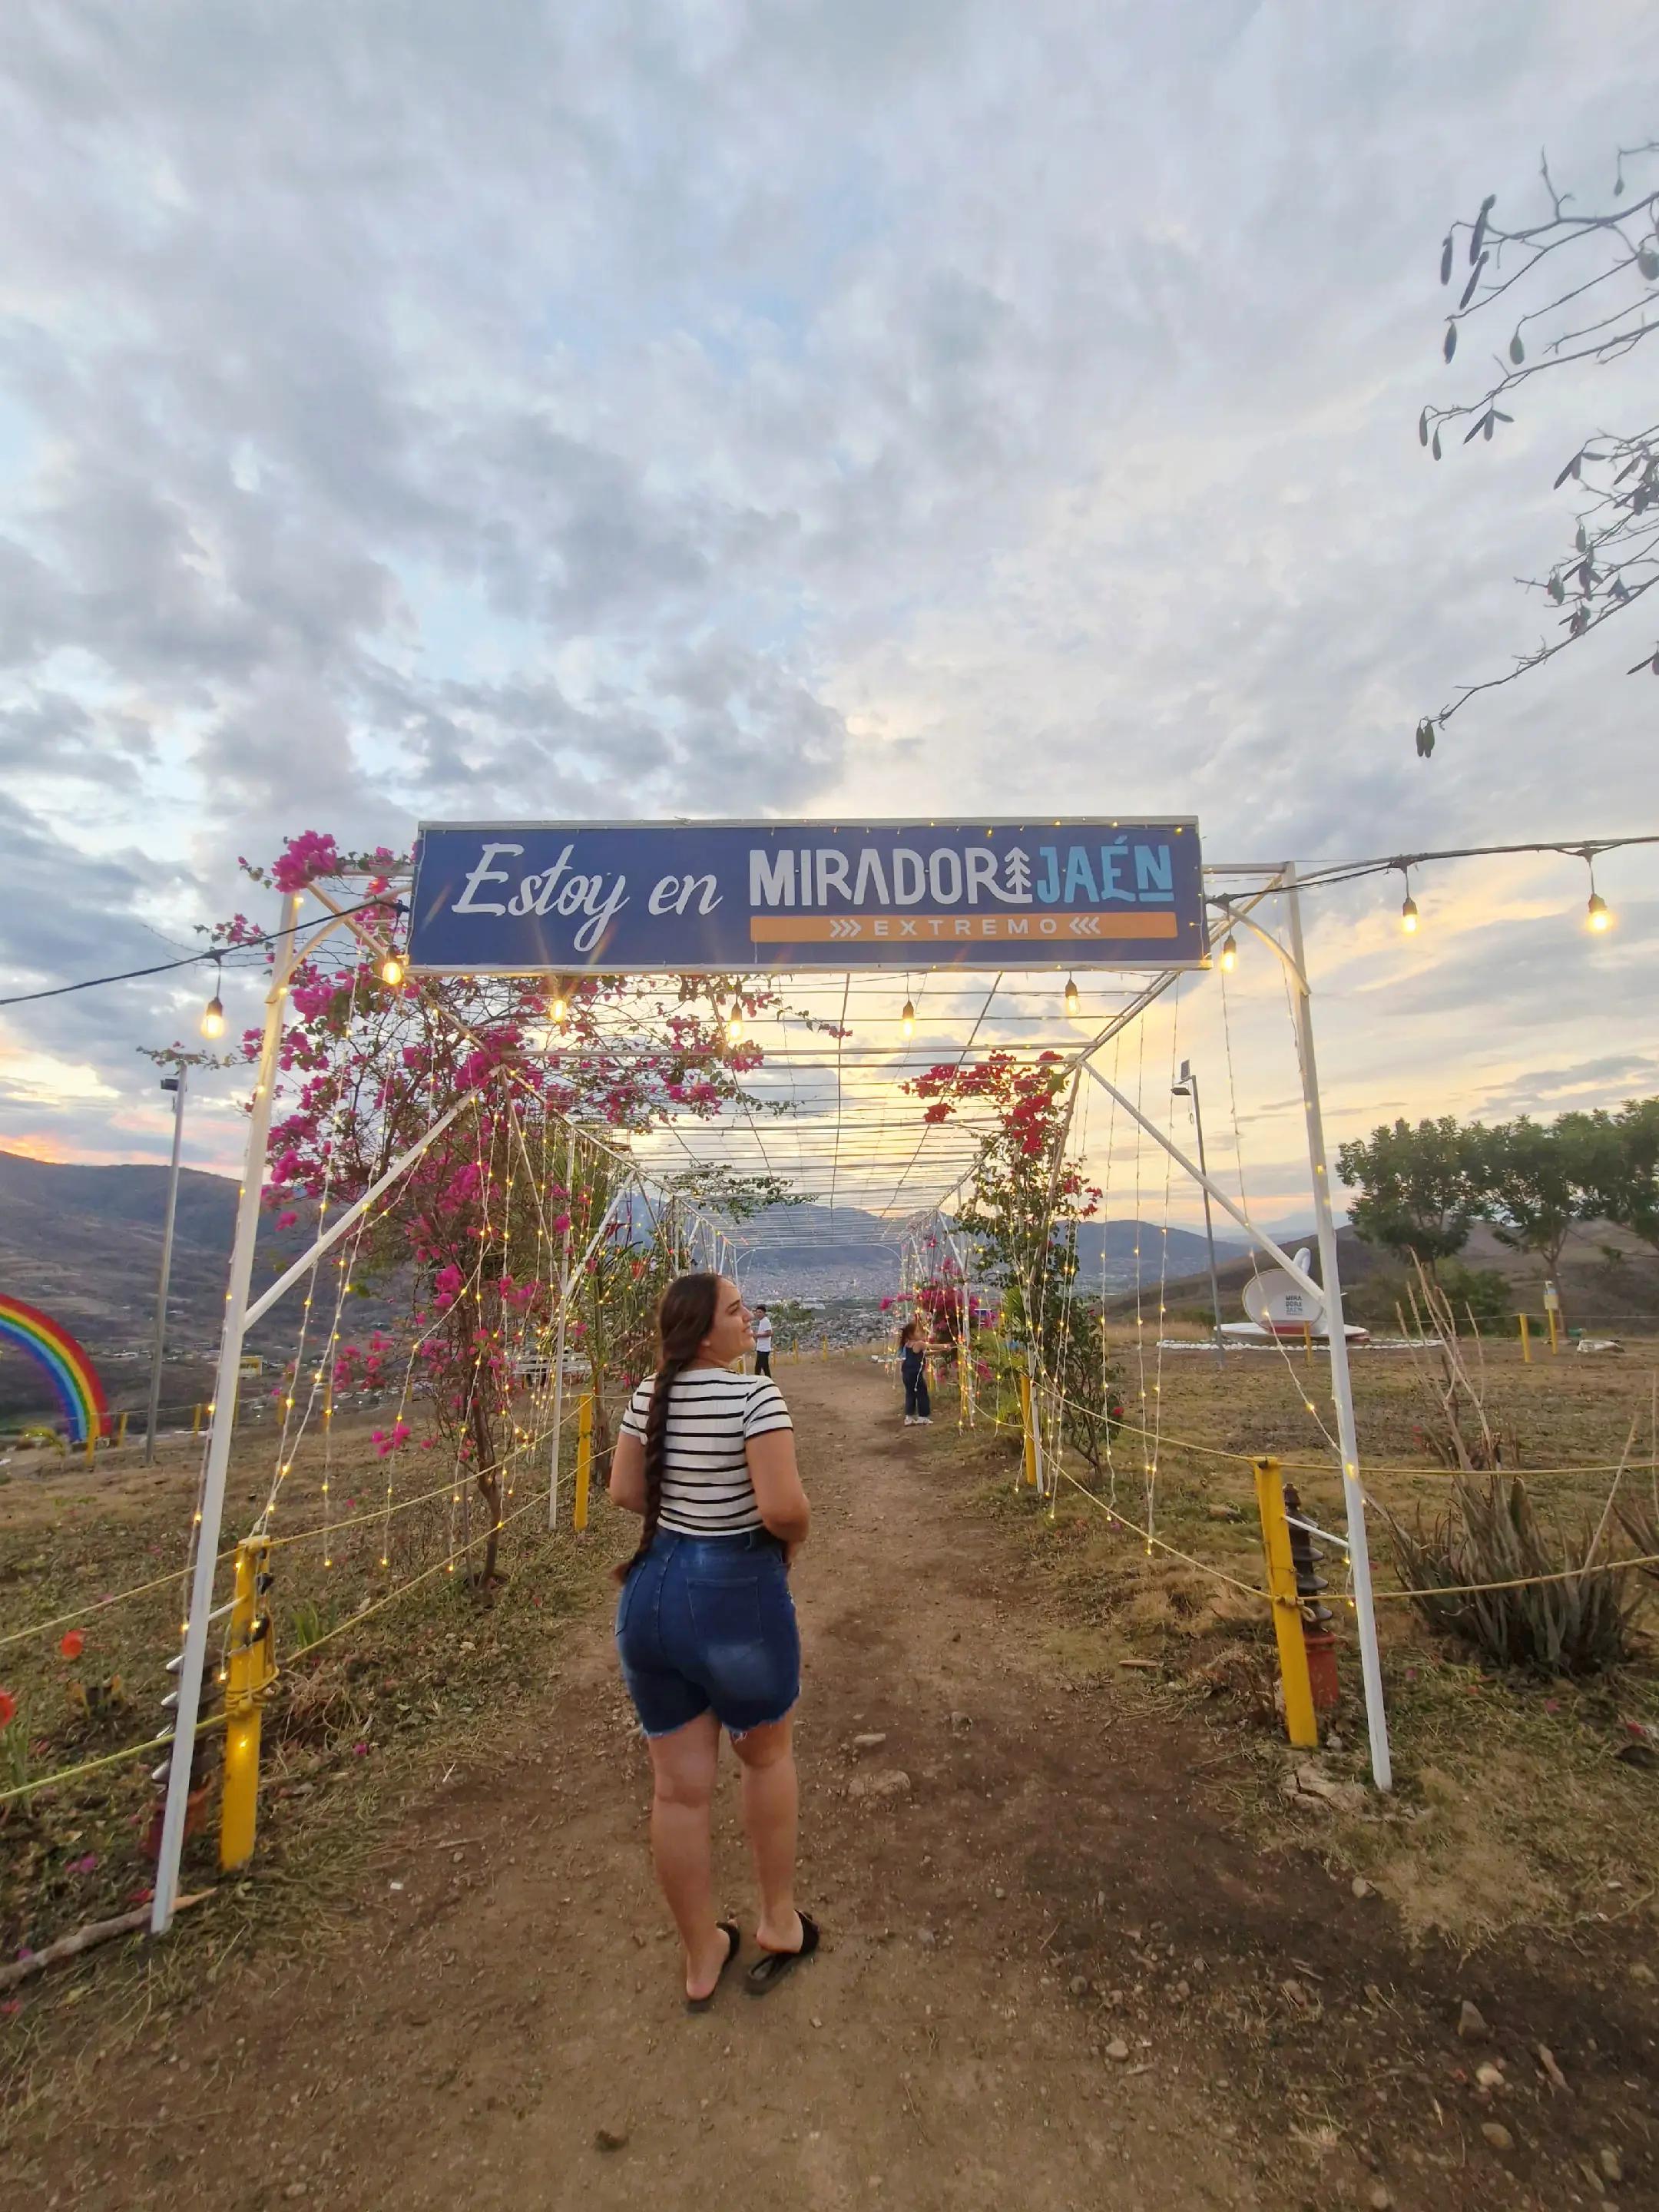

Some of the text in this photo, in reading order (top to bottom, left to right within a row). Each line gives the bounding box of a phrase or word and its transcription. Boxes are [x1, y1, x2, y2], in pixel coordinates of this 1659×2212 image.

[452, 835, 1174, 952] Estoy en MIRADOR JAÉN
[874, 918, 1057, 936] EXTREMO
